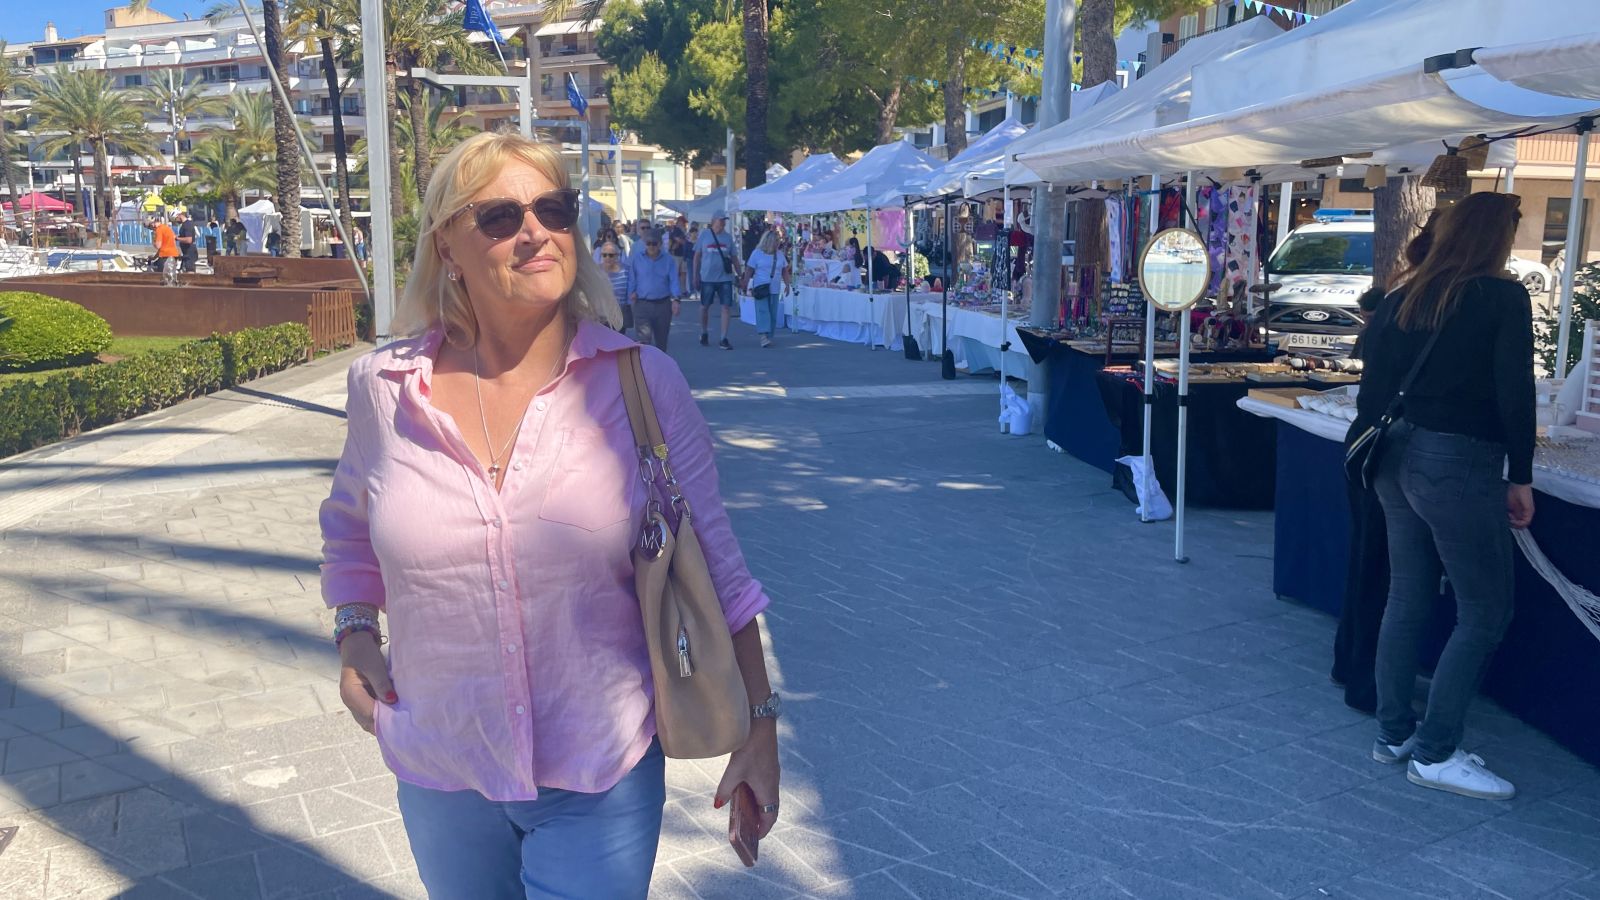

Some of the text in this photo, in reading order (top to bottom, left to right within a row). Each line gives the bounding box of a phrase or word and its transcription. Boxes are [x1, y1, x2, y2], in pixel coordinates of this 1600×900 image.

[1289, 287, 1355, 295] POLICIA
[1291, 334, 1318, 345] 6616
[641, 529, 662, 550] MK
